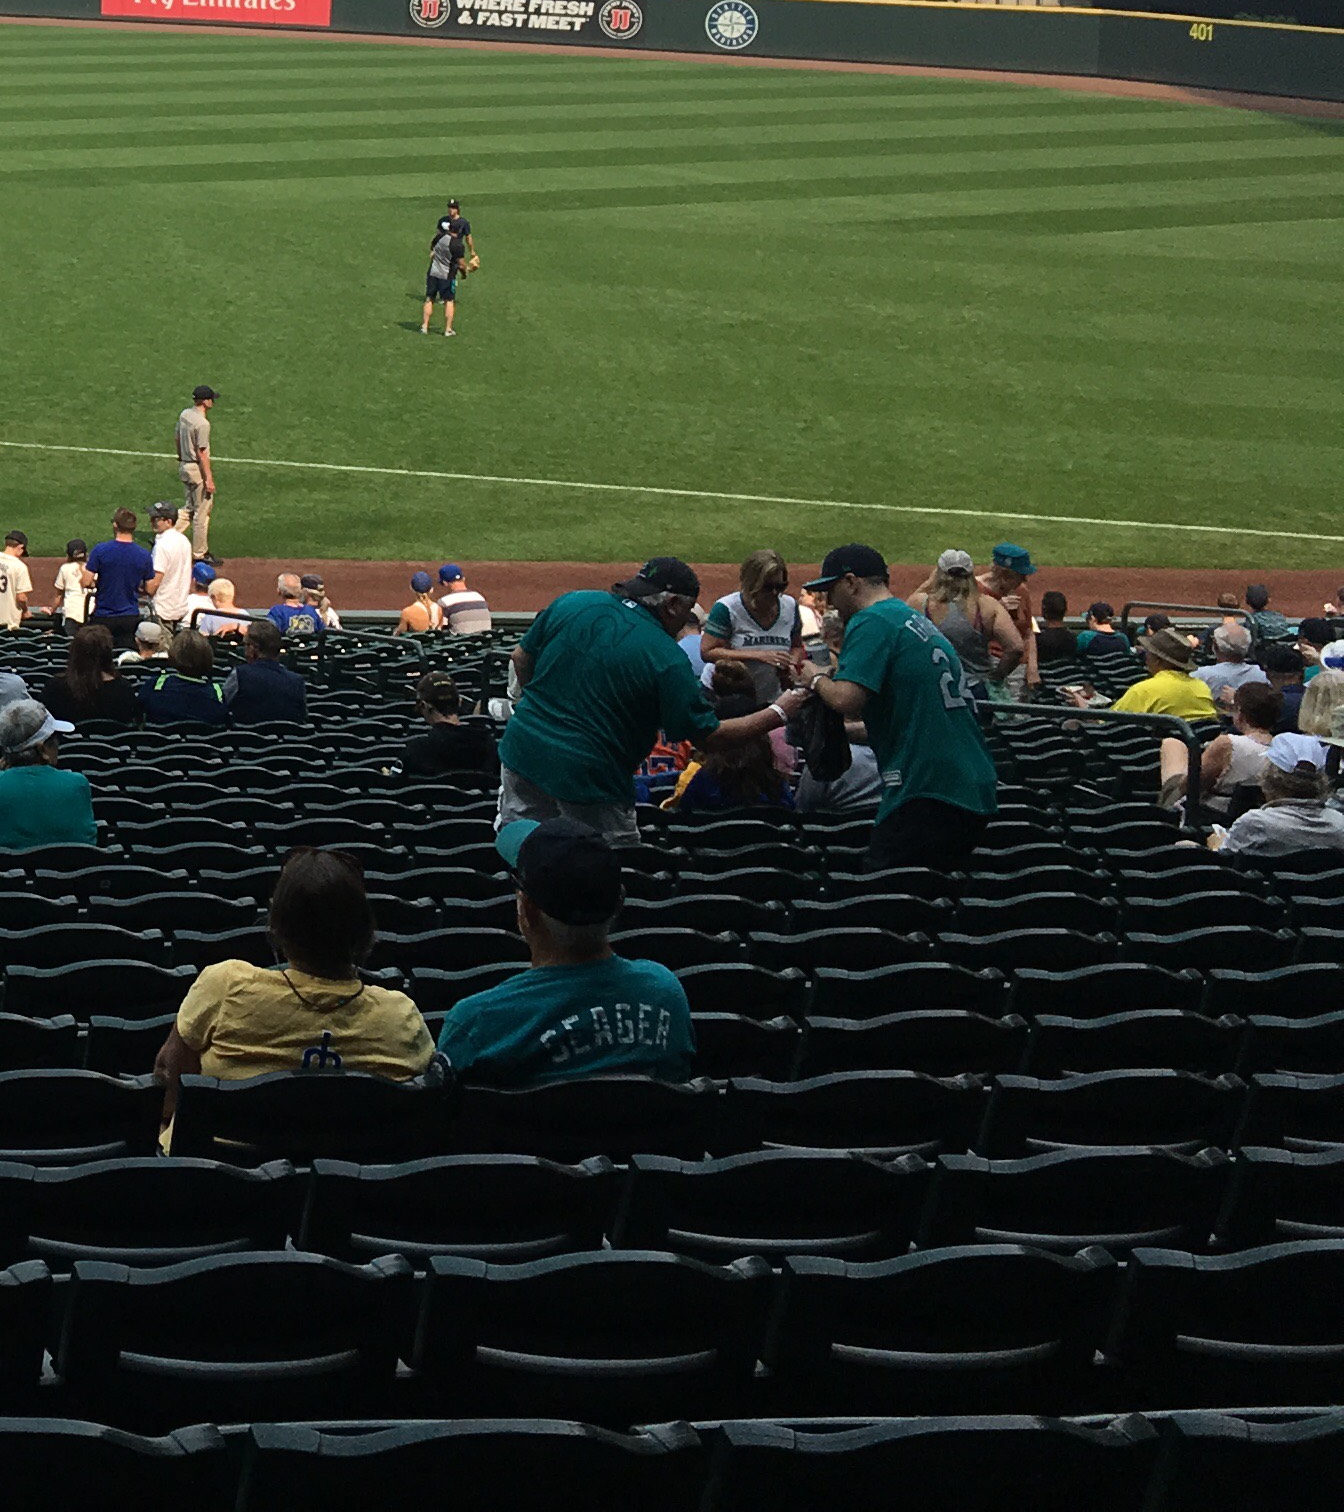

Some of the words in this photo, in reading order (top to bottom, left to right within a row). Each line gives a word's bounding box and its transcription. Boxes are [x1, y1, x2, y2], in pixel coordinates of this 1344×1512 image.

[457, 10, 472, 25] &
[476, 11, 527, 29] FAST
[527, 13, 587, 31] MEET
[610, 8, 631, 30] JJ
[1189, 23, 1214, 41] 401
[742, 635, 791, 648] MARINERS
[539, 1002, 671, 1064] SEAGER
